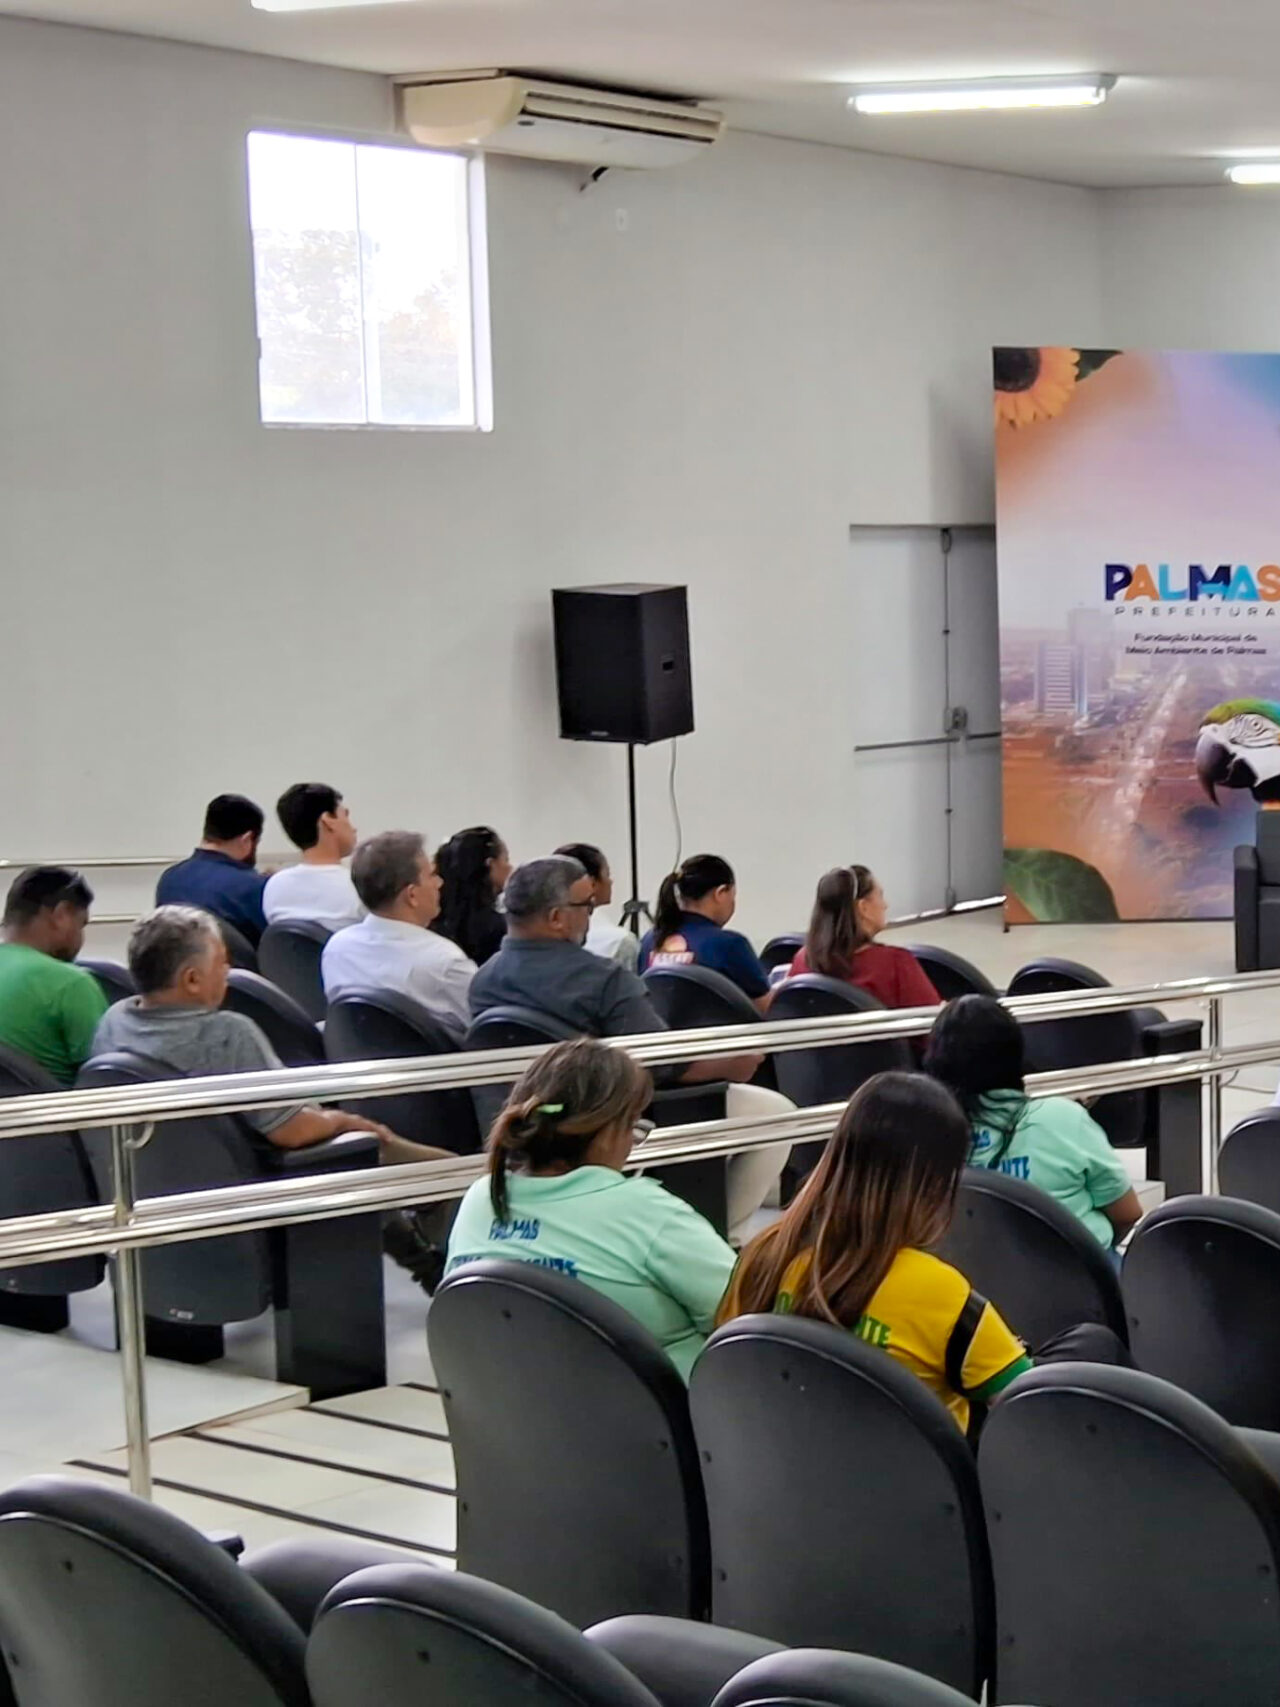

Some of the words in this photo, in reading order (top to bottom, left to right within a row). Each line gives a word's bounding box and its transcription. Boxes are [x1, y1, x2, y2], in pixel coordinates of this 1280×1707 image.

[1114, 606, 1276, 616] PREFEITURA
[1134, 632, 1189, 643] Fundação
[1191, 633, 1241, 643] Municipal
[1244, 633, 1257, 642] de
[1125, 646, 1152, 655] Meio
[1154, 646, 1208, 655] Ambiente
[1211, 646, 1224, 655] de
[1226, 646, 1267, 655] Palmas
